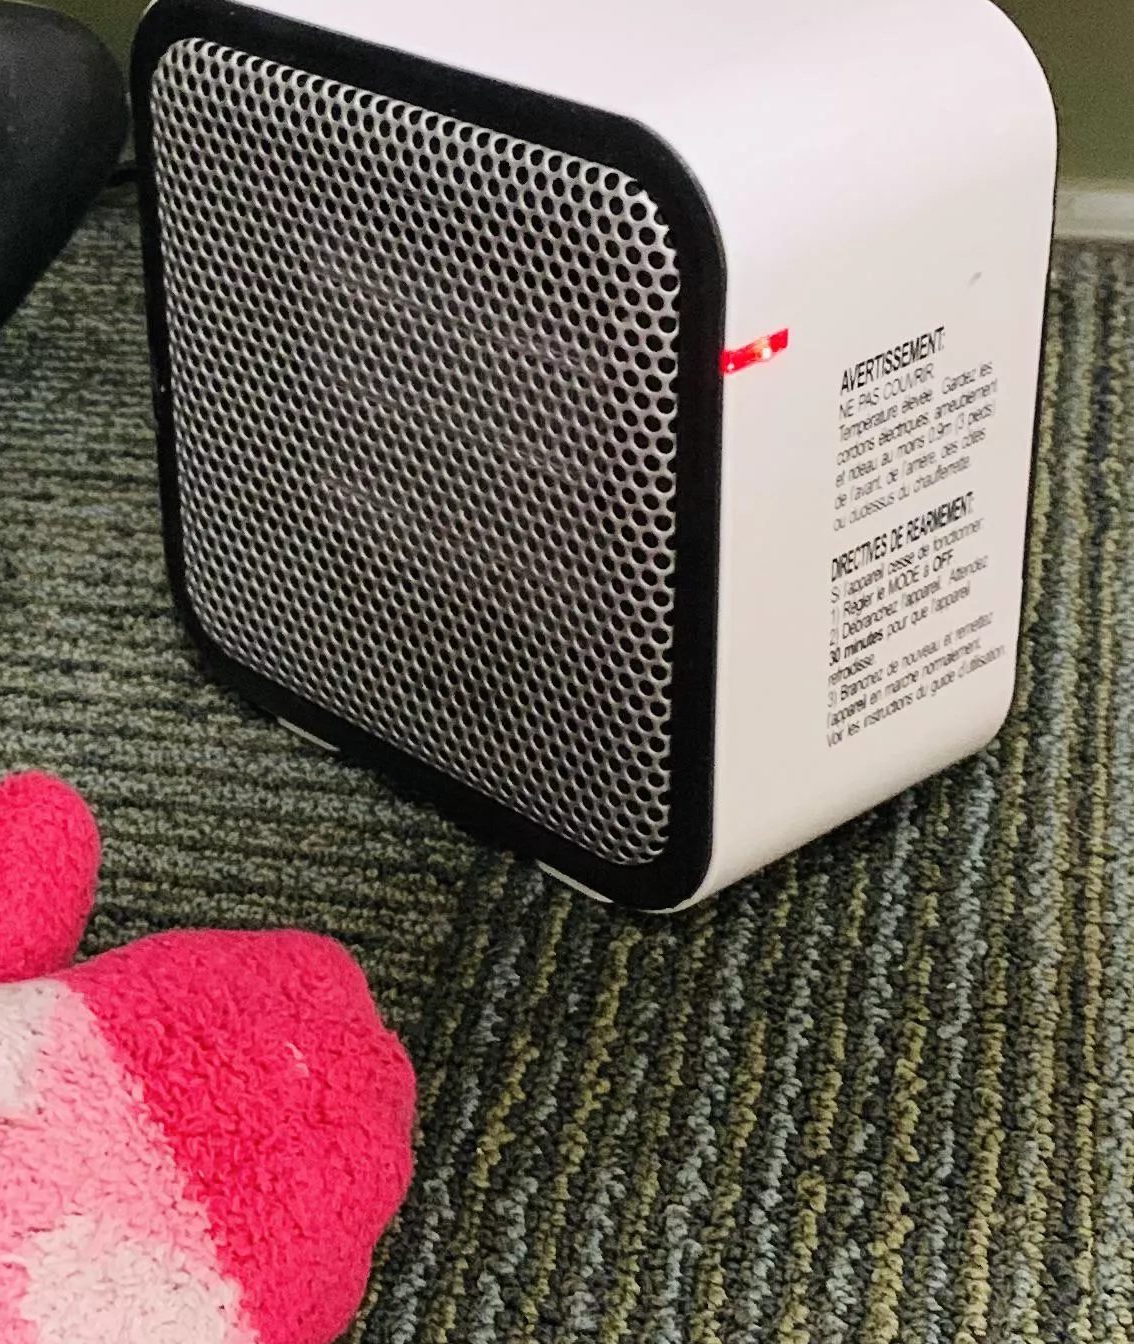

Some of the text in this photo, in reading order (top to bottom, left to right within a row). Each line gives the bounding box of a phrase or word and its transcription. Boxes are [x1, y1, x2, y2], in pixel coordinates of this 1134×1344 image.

[941, 368, 976, 394] Gardez
[836, 437, 875, 466] cordons
[897, 435, 925, 459] moins
[831, 533, 887, 582] DIRECTIVES
[888, 566, 919, 595] MODE
[844, 629, 884, 659] minutes
[887, 616, 908, 640] pour
[841, 667, 883, 701] Branchez
[901, 637, 940, 667] nouveau
[885, 670, 919, 697] marche
[826, 729, 844, 748] Voir
[864, 691, 913, 728] instructions
[930, 669, 956, 696] guide
